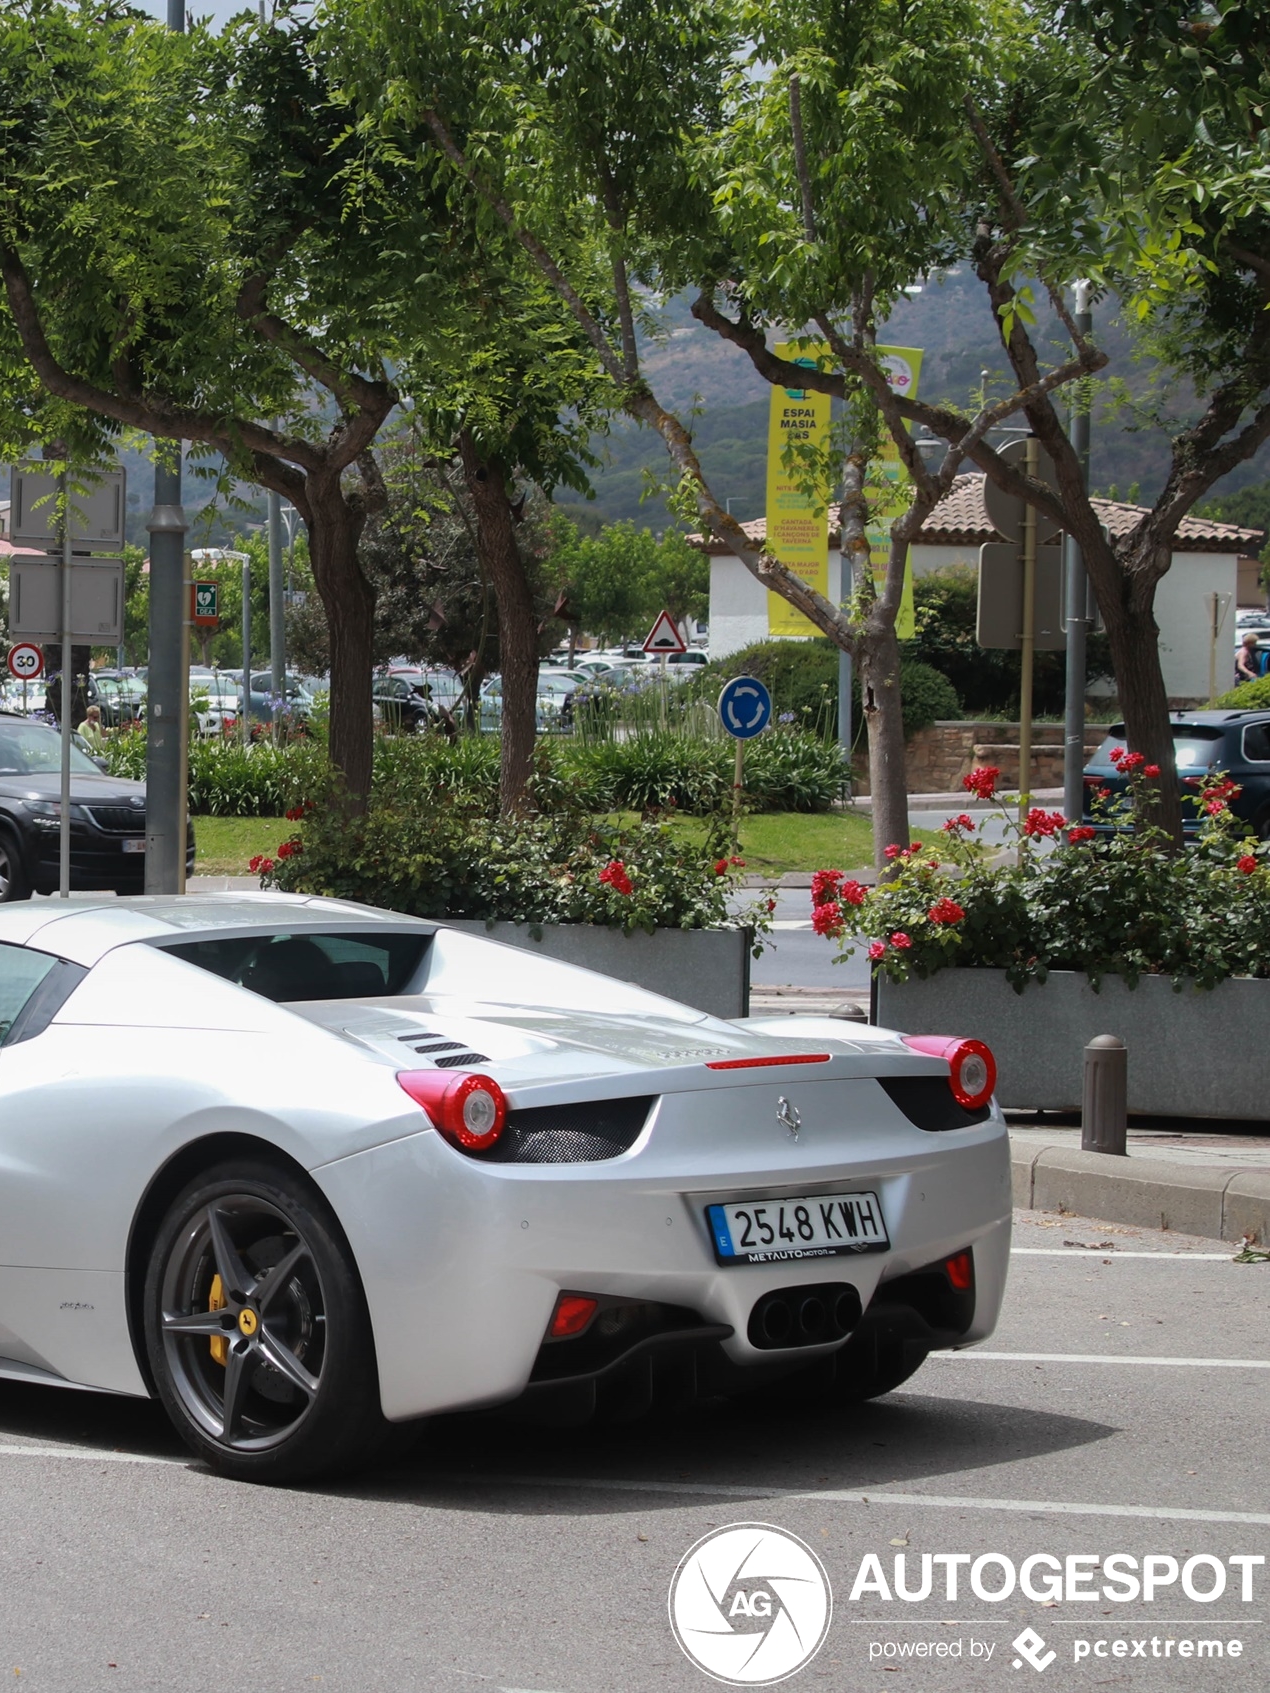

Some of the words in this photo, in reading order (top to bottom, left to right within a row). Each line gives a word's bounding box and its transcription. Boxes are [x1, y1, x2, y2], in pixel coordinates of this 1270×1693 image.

[783, 408, 815, 418] ESPAI
[780, 419, 817, 429] MASIA
[199, 608, 213, 616] DEA
[16, 655, 35, 668] 30
[734, 1205, 814, 1248] 2548
[819, 1200, 879, 1239] KWH
[719, 1236, 728, 1247] E
